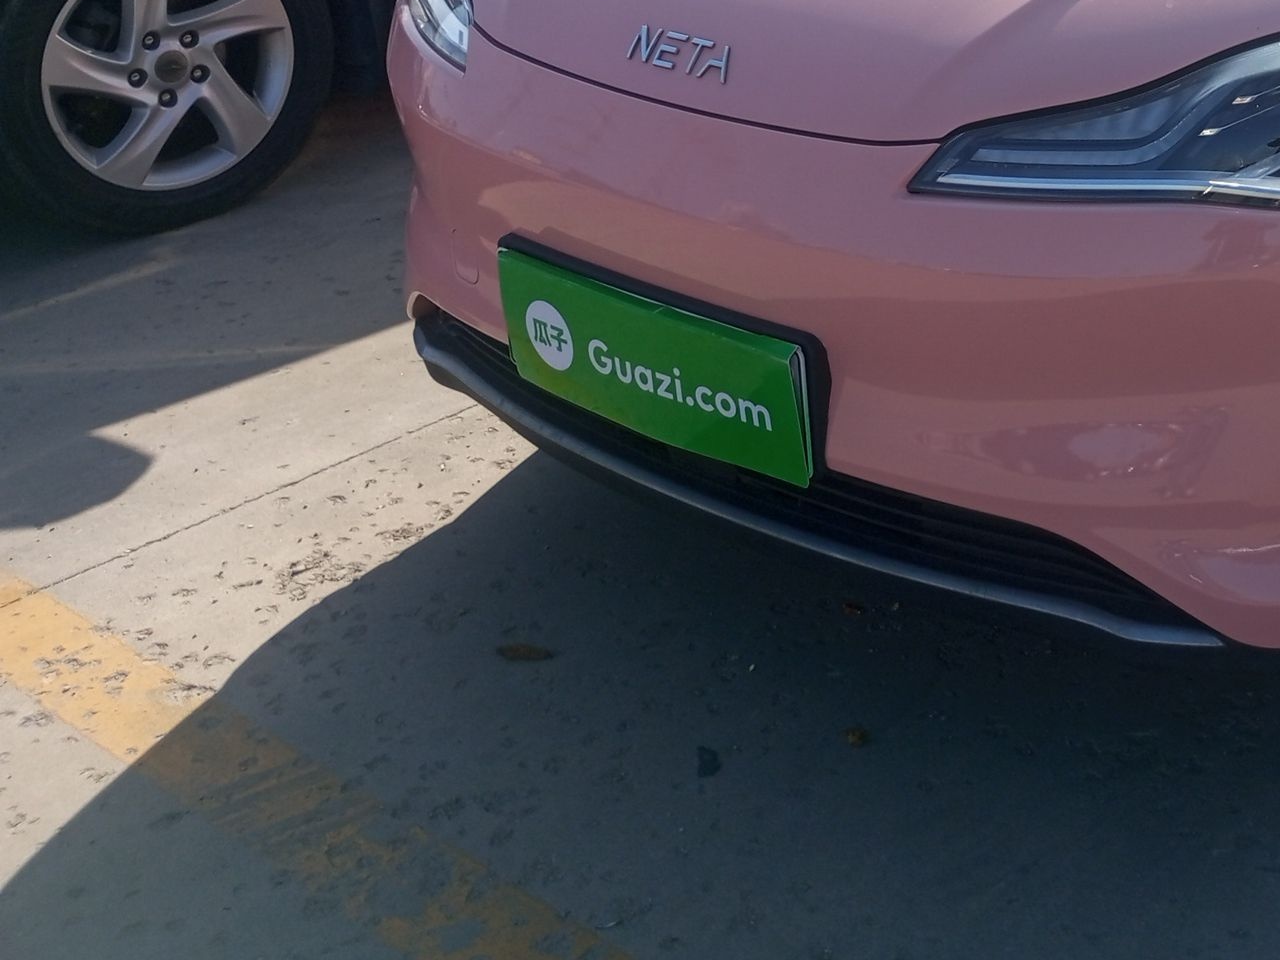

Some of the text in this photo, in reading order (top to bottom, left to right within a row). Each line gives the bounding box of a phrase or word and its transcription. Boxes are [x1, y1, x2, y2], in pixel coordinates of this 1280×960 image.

[626, 23, 731, 85] NETA
[533, 317, 568, 353] 瓜子
[588, 339, 773, 433] Guazi.com
